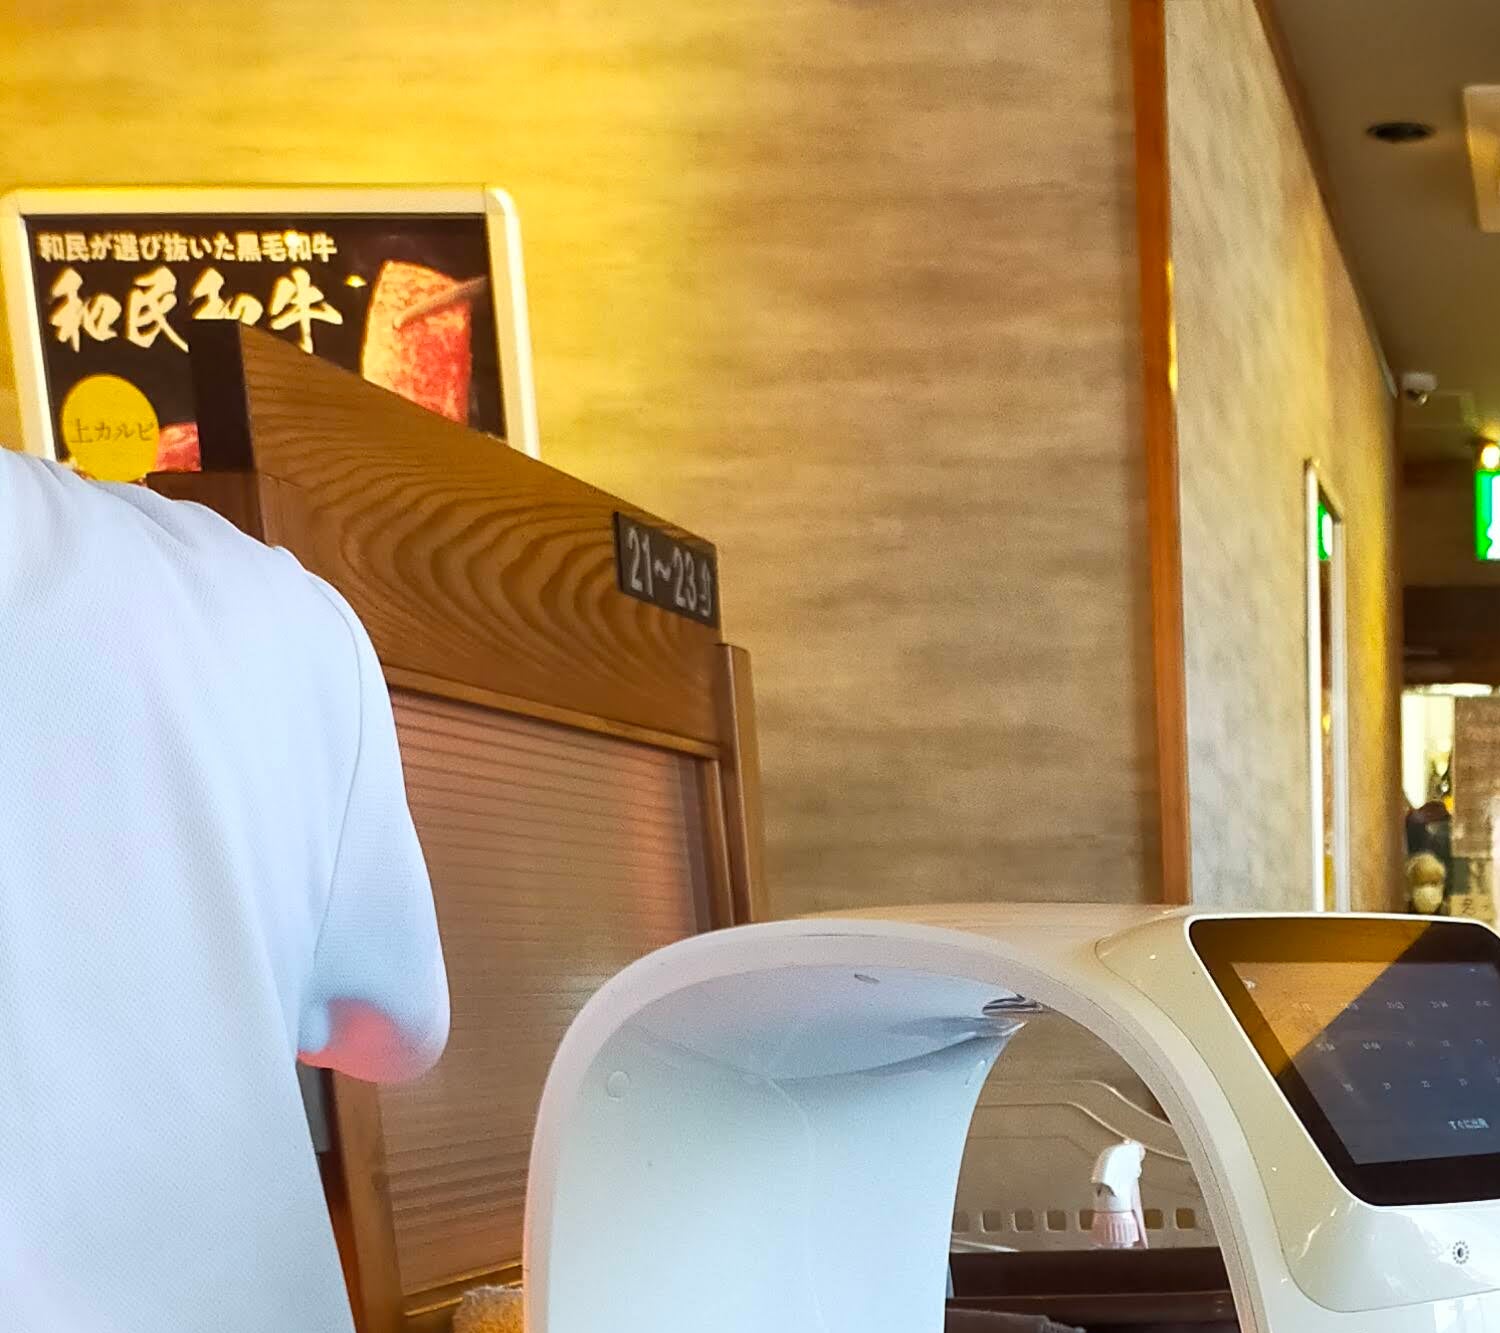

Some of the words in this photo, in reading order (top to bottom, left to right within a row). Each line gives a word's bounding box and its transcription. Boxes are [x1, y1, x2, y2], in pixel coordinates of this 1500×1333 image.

[37, 230, 338, 262] 和民が選び抜いた黒毛和牛
